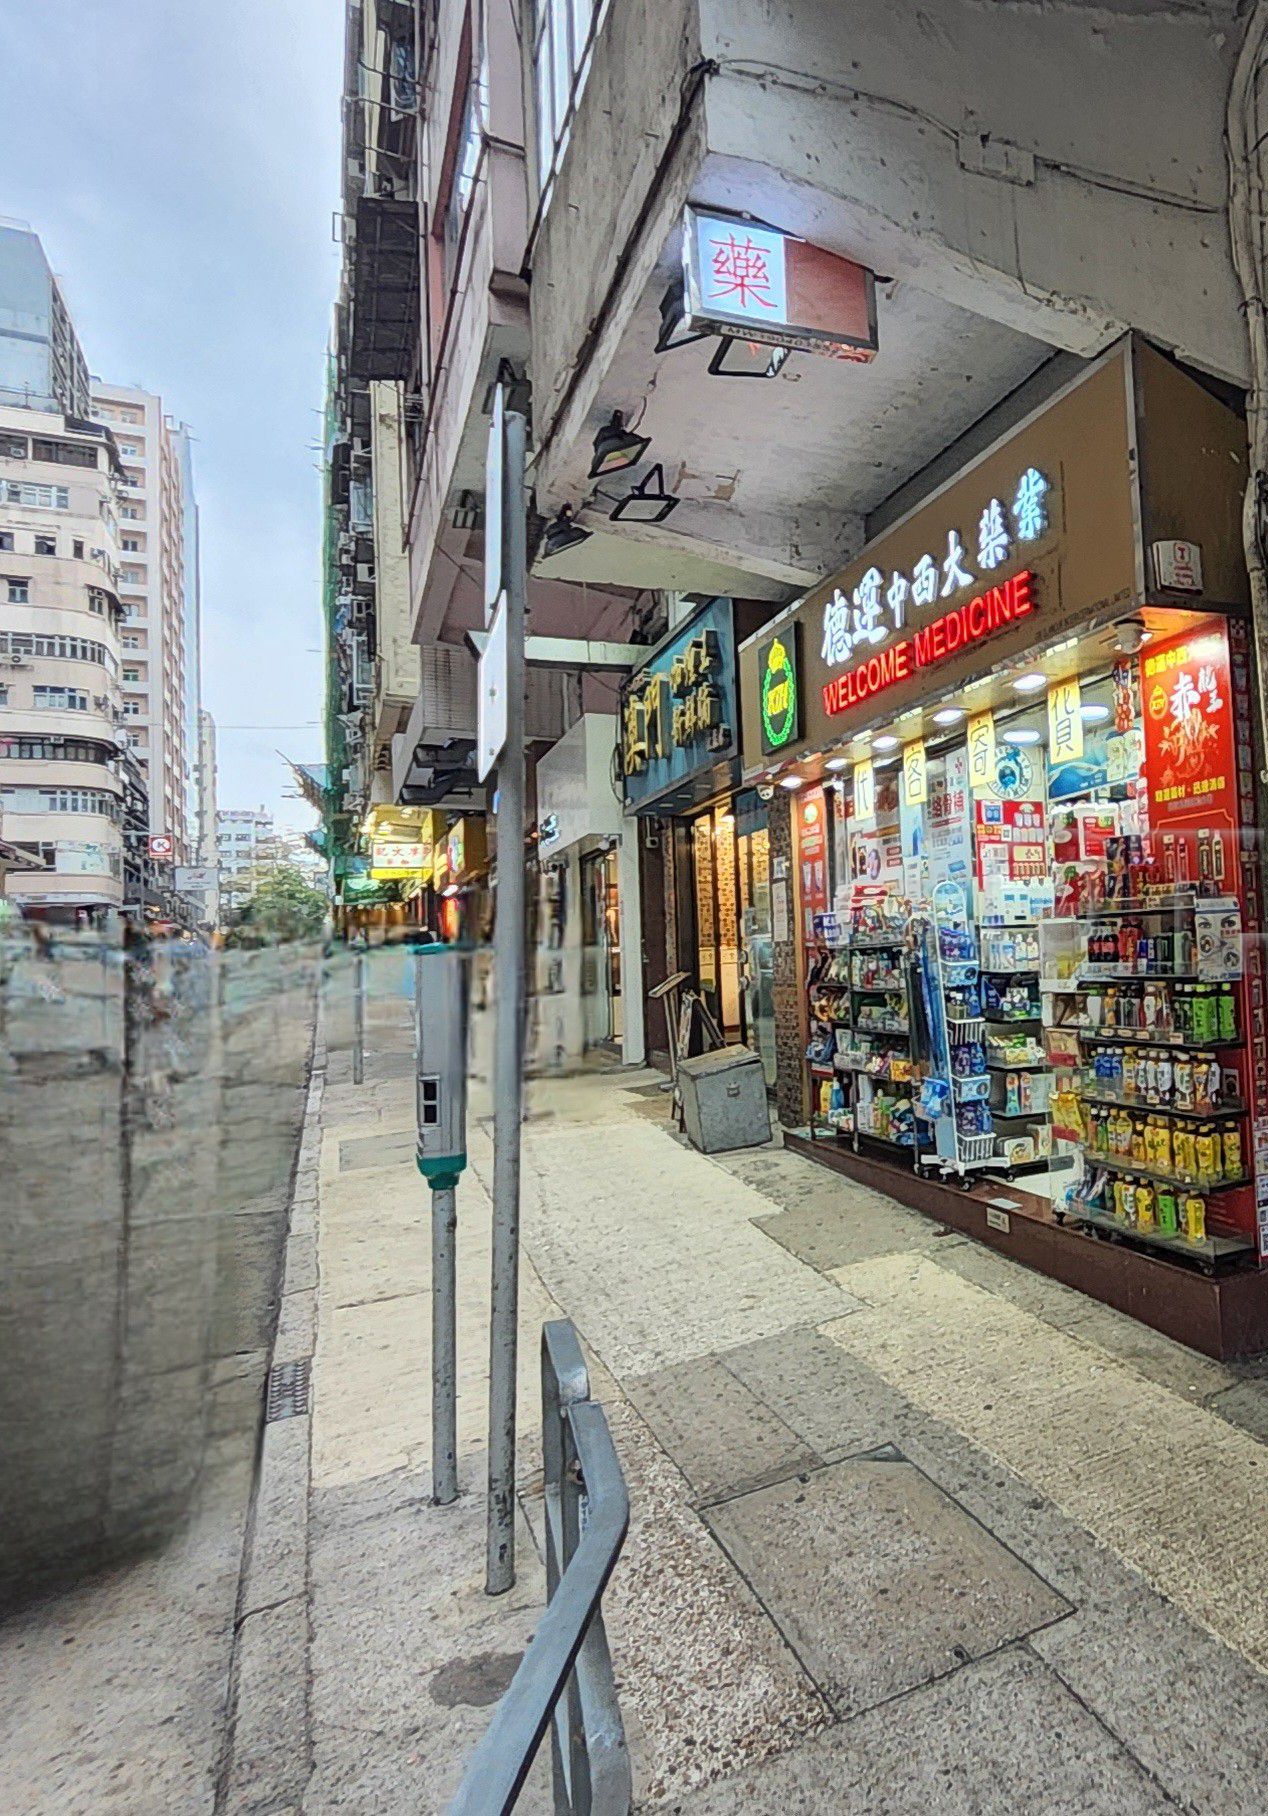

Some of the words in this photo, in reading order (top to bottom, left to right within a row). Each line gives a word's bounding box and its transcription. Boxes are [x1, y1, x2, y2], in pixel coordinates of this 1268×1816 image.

[708, 234, 779, 308] 藥
[822, 640, 912, 716] WELCOME
[912, 570, 1034, 668] MEDICINE
[906, 746, 922, 797] 客
